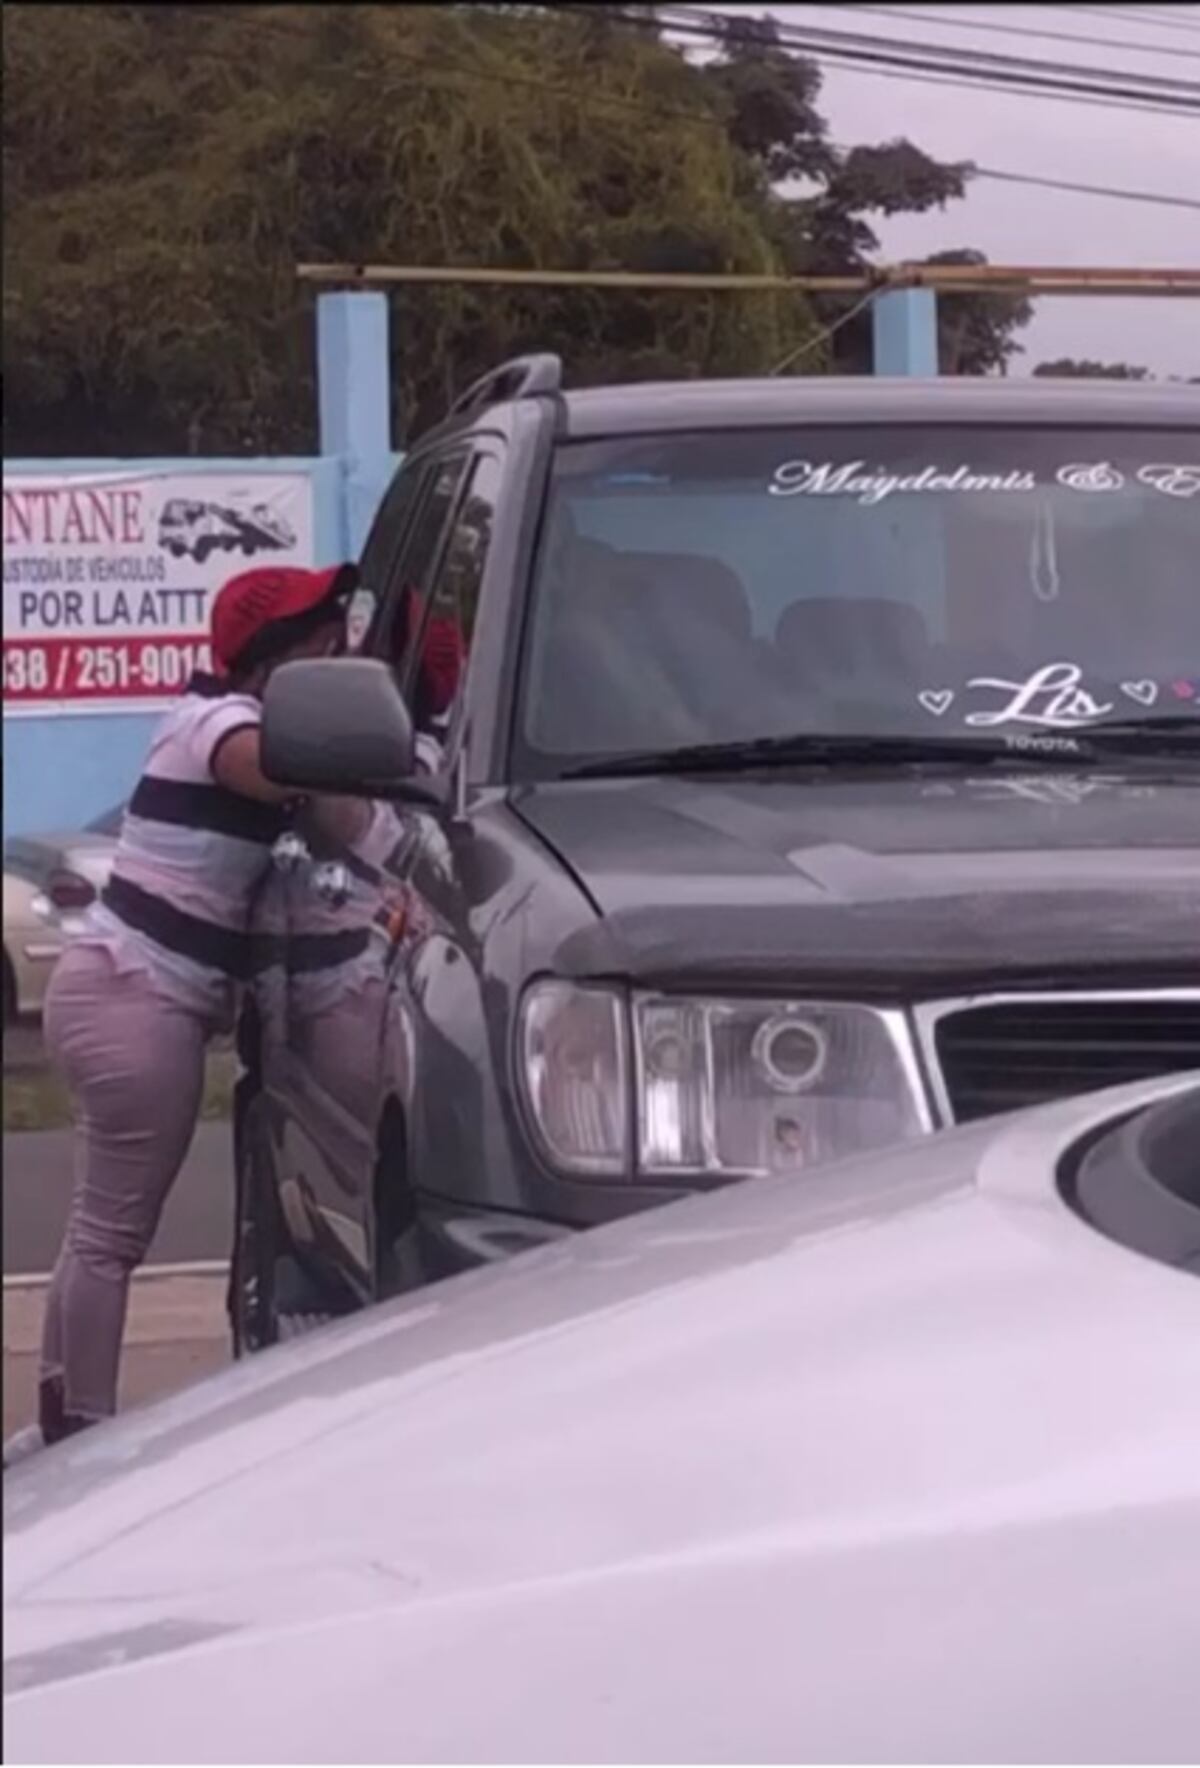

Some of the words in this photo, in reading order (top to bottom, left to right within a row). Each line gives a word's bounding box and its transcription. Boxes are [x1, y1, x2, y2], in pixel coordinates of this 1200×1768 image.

[4, 490, 144, 543] NTANE
[66, 556, 84, 582] DE
[20, 590, 83, 627] POR
[93, 589, 131, 626] LA
[138, 588, 207, 625] ATTT
[965, 662, 1114, 727] Lis
[1005, 735, 1079, 752] TOYOTA
